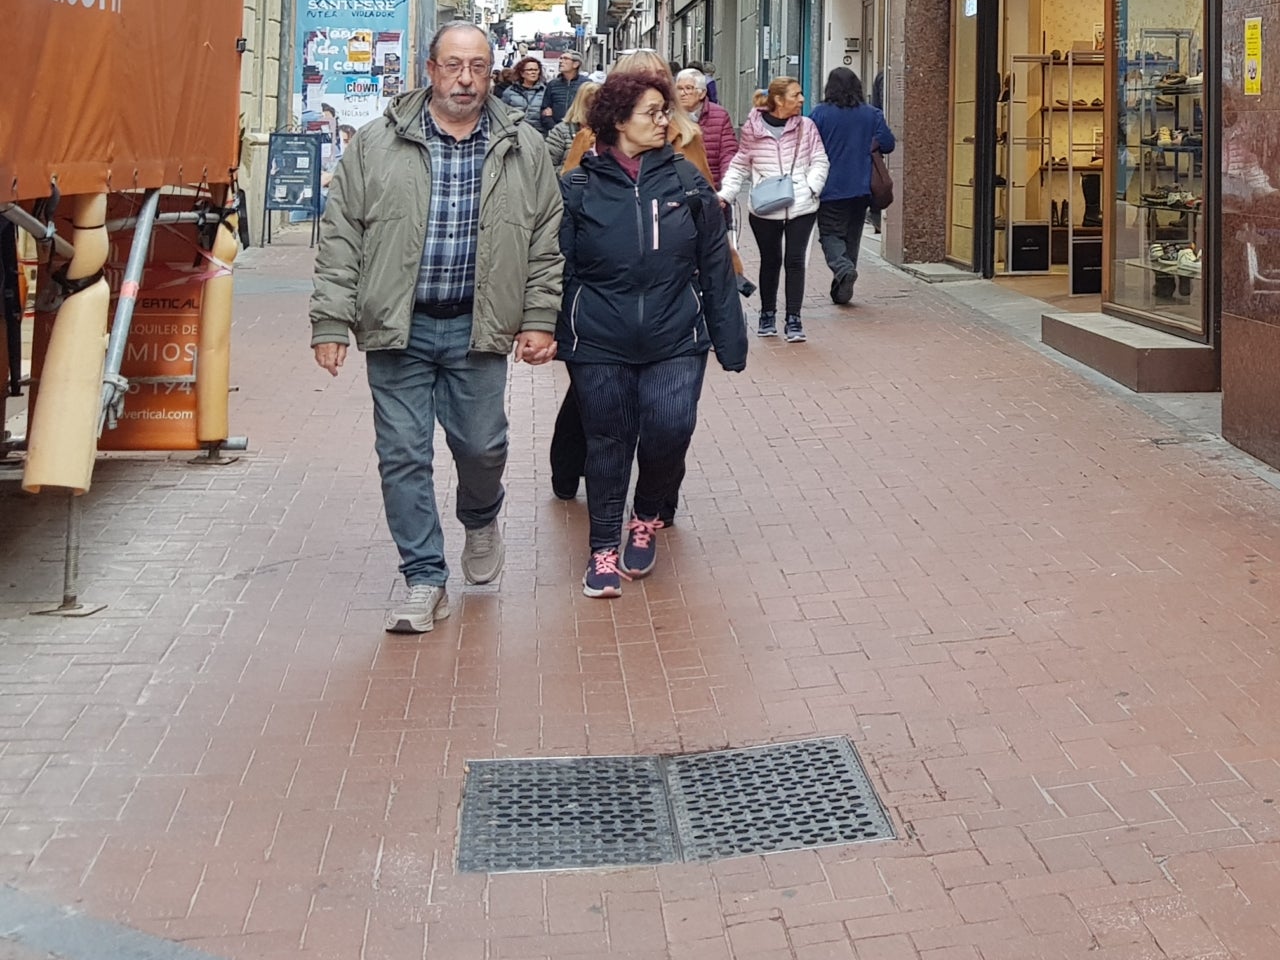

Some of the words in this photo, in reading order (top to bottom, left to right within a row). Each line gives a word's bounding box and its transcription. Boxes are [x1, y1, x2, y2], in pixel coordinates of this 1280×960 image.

[346, 82, 379, 94] clown
[129, 323, 178, 335] LQUILER
[182, 324, 198, 335] DE
[127, 342, 197, 362] MIOS
